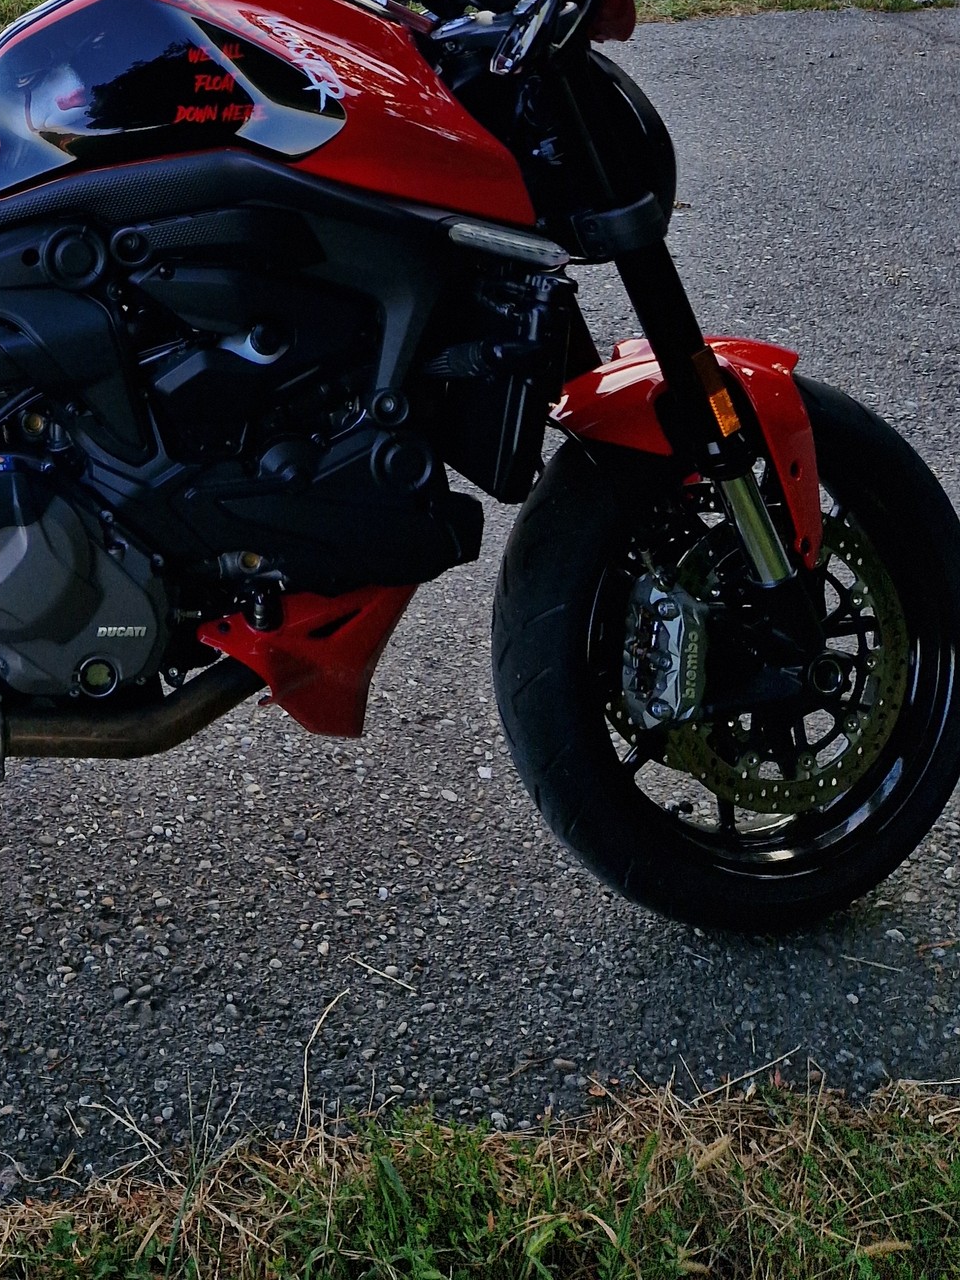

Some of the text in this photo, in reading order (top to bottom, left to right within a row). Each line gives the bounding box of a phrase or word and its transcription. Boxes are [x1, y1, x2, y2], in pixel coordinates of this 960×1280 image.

[187, 45, 211, 63] WE
[173, 103, 268, 124] DOWN HERE
[96, 626, 147, 637] DUCATI
[682, 631, 698, 698] brembo
